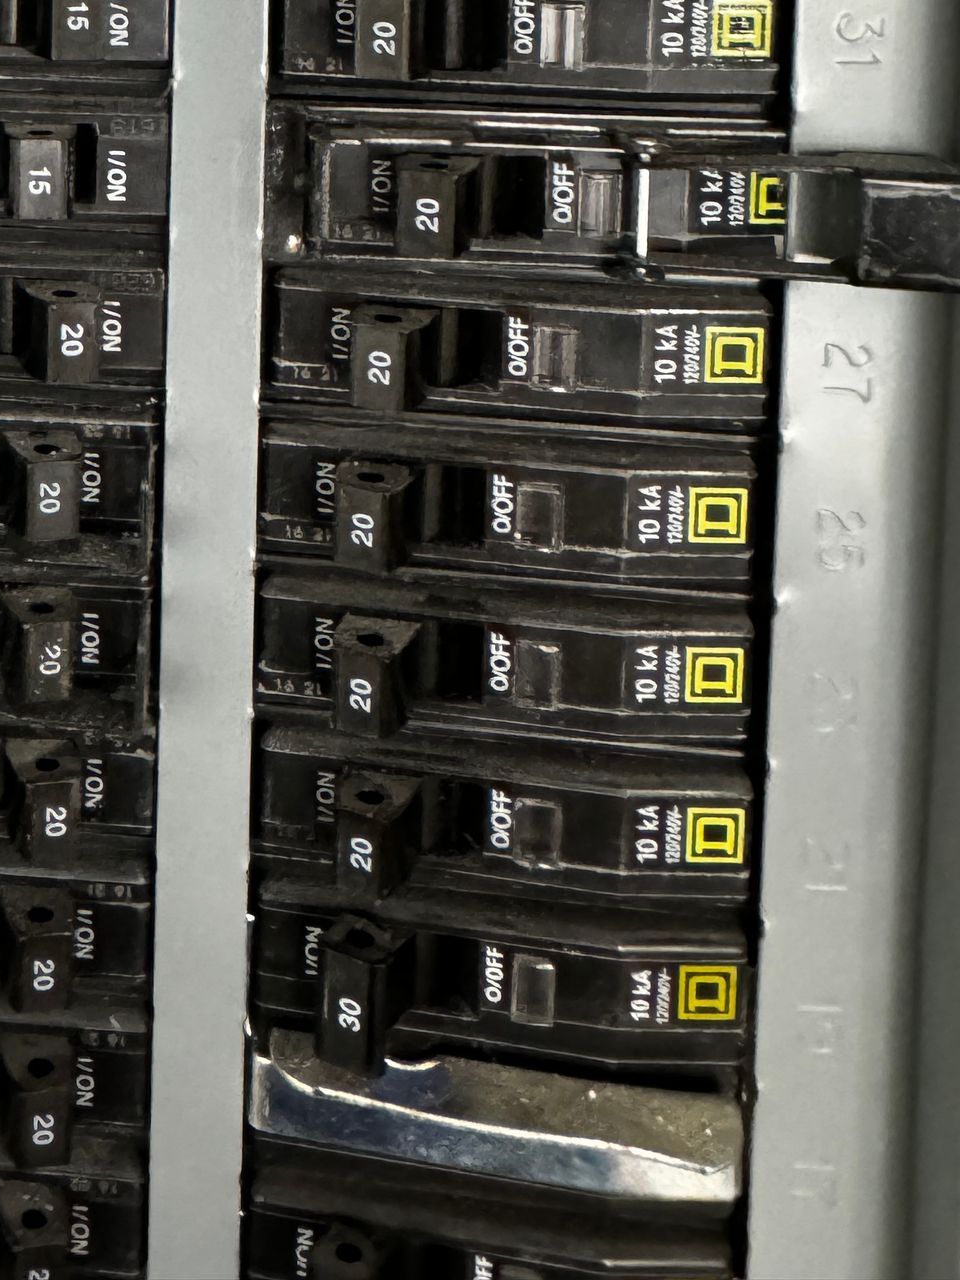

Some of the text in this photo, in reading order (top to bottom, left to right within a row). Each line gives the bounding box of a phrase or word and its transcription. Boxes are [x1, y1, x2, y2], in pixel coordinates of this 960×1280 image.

[67, 2, 89, 31] 15
[372, 21, 396, 56] 20
[661, 30, 683, 57] 10
[834, 13, 885, 66] 31
[28, 167, 51, 196] 15
[415, 198, 439, 233] 20
[700, 199, 722, 227] 10
[60, 324, 84, 357] 20
[102, 301, 121, 353] I/ON
[332, 308, 351, 359] I/ON
[368, 351, 392, 386] 20
[655, 324, 677, 383] 10 kA
[822, 342, 872, 404] 27
[40, 482, 60, 514] 20
[316, 461, 335, 514] I/ON
[351, 512, 375, 547] 20
[638, 484, 662, 543] 10 kA
[40, 645, 61, 676] 20
[635, 644, 658, 702] 10 kA
[350, 678, 371, 713] 20
[45, 807, 67, 838] 20
[636, 804, 659, 864] 10 kA
[350, 837, 372, 872] 20
[34, 959, 55, 992] 20
[630, 969, 652, 1022] 10 kA
[339, 998, 362, 1032] 30
[33, 1114, 54, 1146] 20
